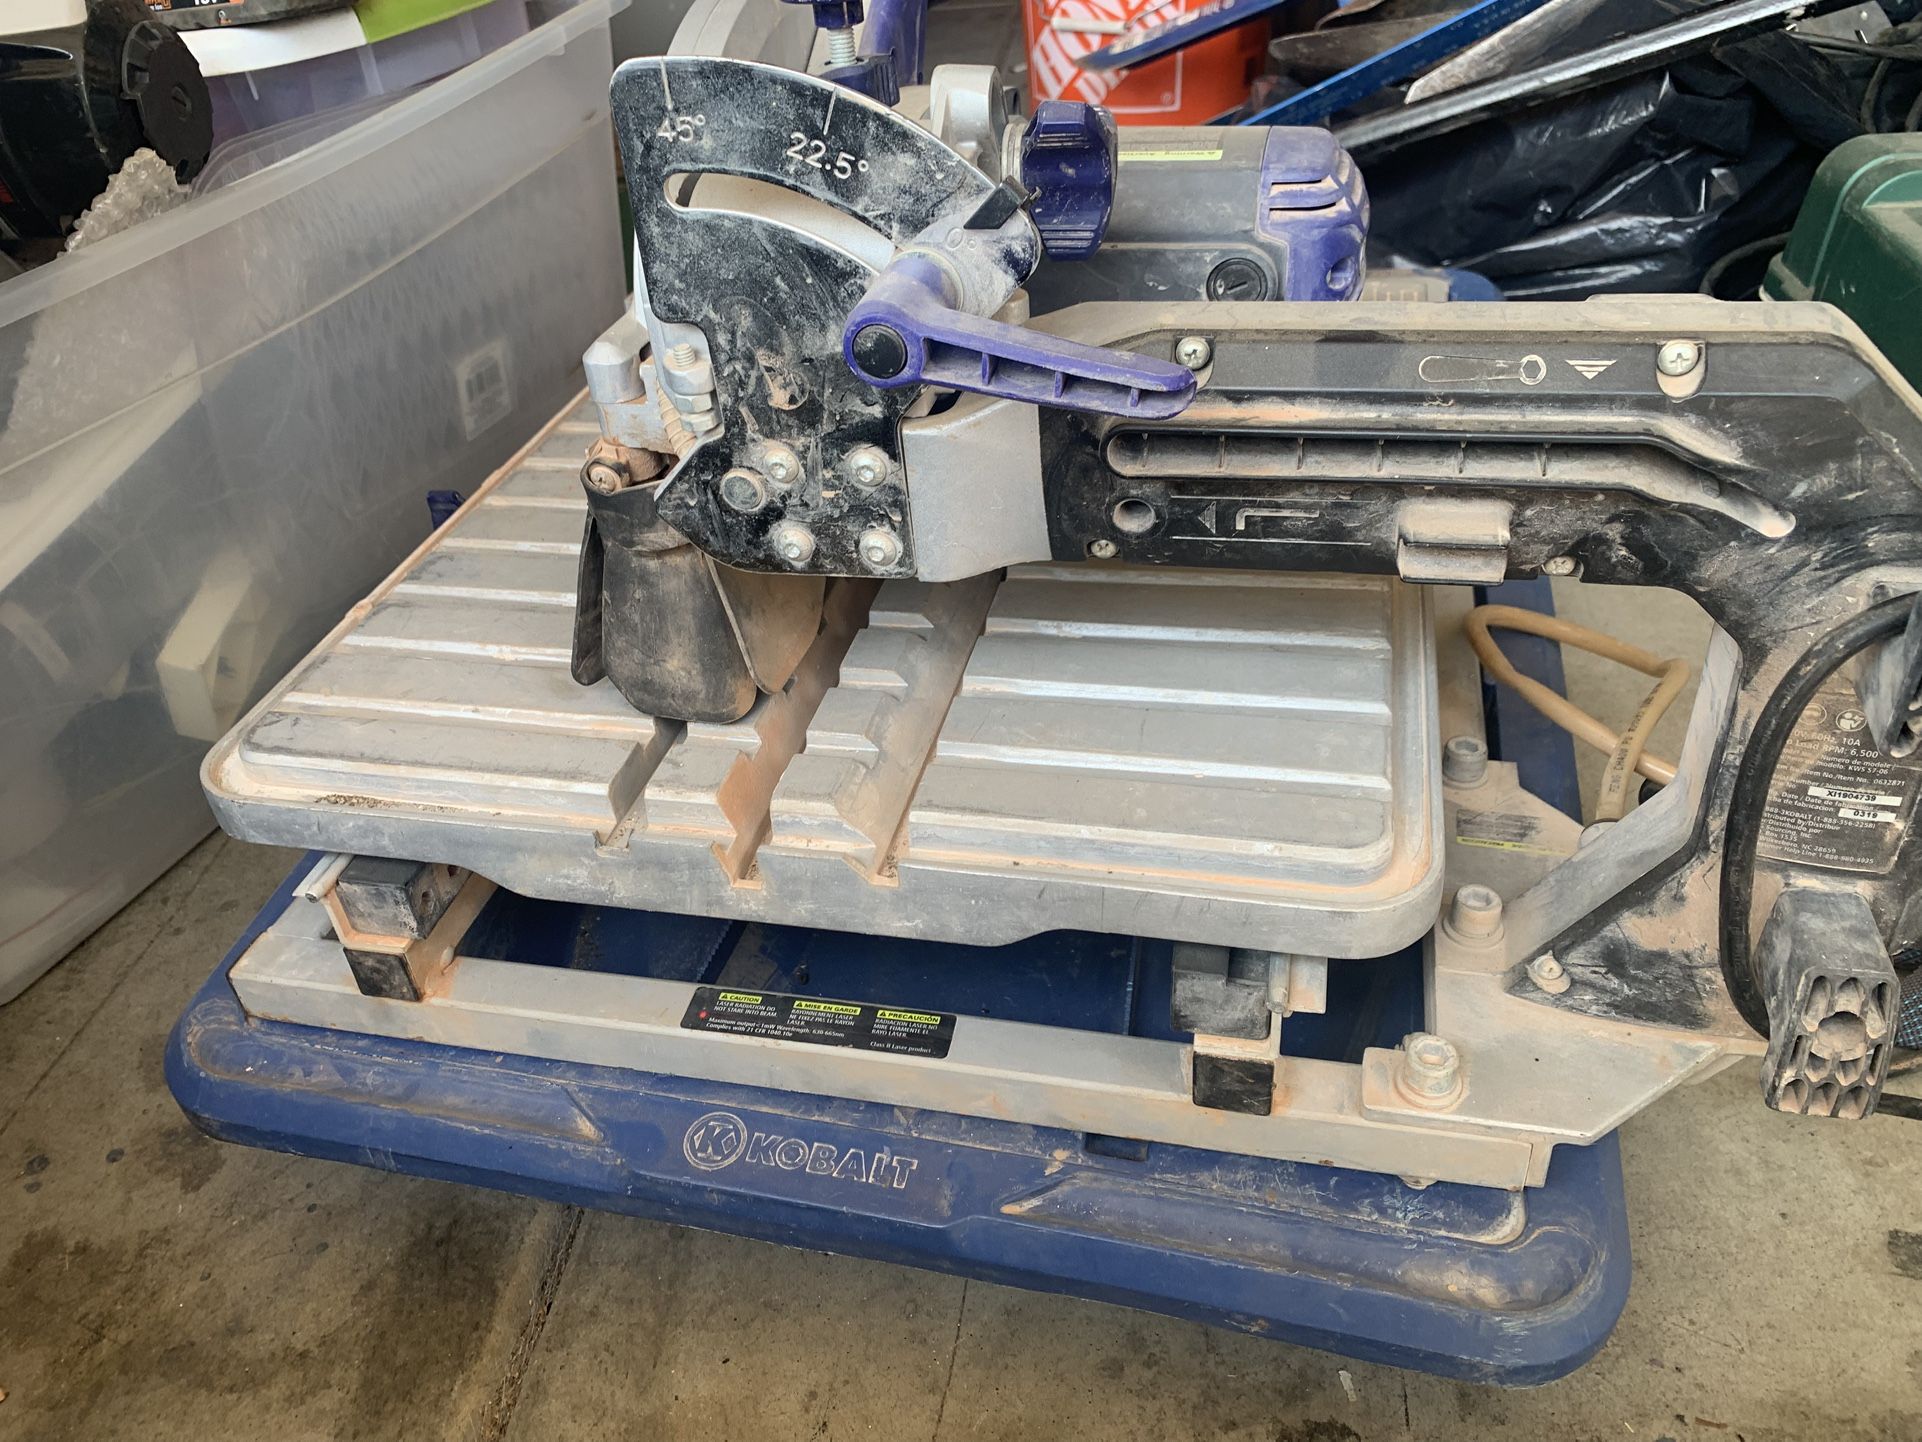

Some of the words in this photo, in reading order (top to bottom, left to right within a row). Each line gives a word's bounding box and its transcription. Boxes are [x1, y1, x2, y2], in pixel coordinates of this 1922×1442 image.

[787, 132, 870, 180] 22.5°
[1842, 737, 1861, 746] 10A
[1850, 747, 1879, 759] 6,500
[1853, 810, 1877, 819] 0319
[734, 1002, 765, 1010] RADIATION
[888, 1012, 939, 1022] PRECAUCIÓN
[746, 1132, 918, 1189] KOBALT
